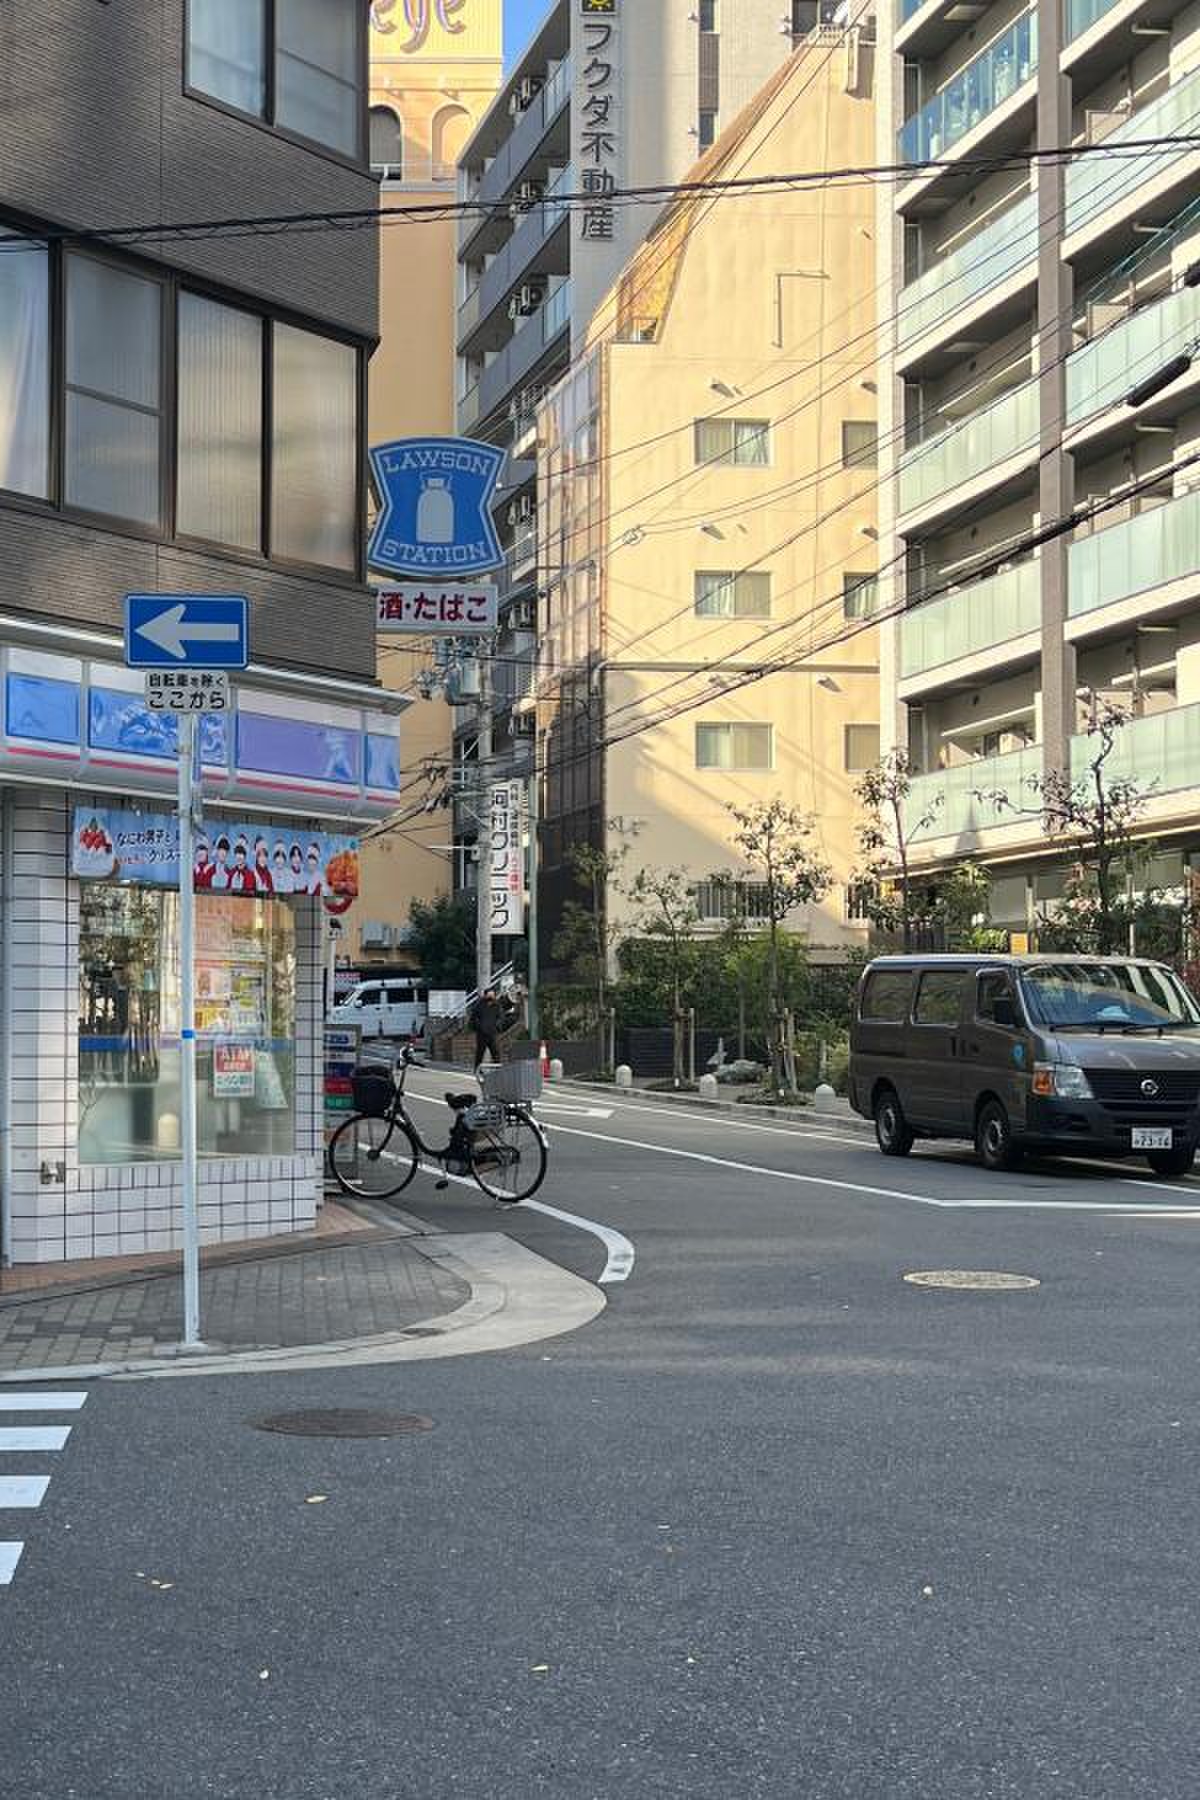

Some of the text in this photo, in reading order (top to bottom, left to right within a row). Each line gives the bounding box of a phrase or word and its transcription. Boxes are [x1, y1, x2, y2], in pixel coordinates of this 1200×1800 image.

[580, 23, 616, 241] フクダ不動産
[383, 450, 492, 474] LAWSON
[382, 539, 487, 562] STATION
[149, 673, 225, 688] 自転車を除く
[149, 690, 225, 709] ここから
